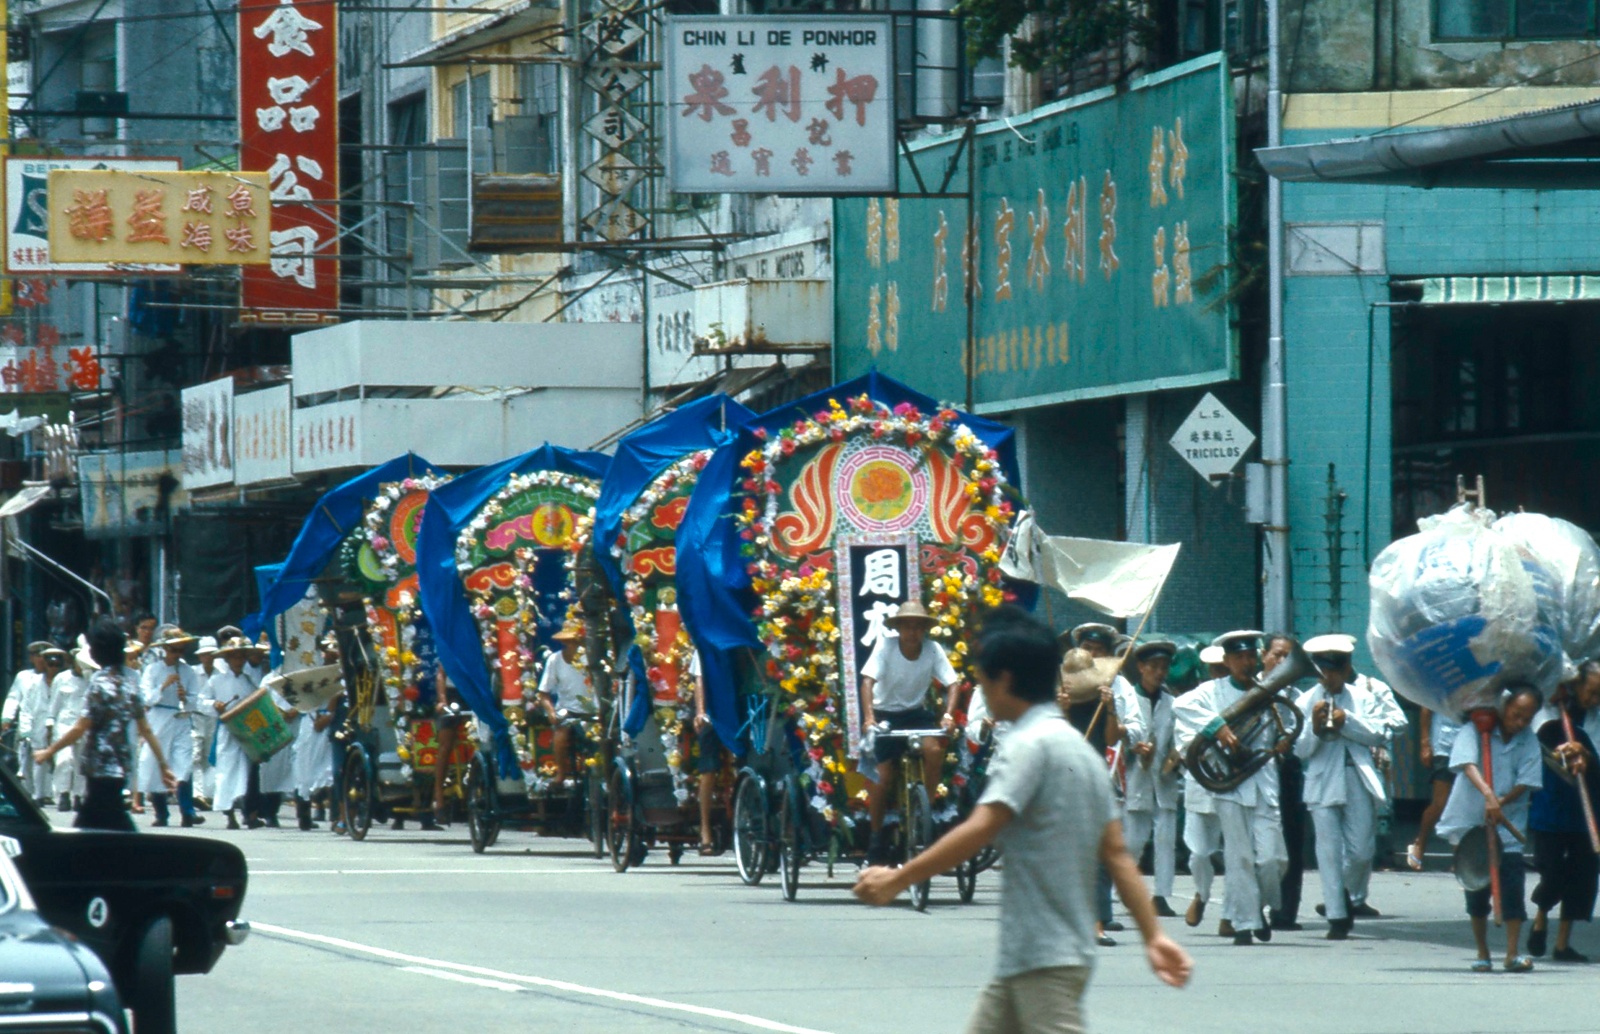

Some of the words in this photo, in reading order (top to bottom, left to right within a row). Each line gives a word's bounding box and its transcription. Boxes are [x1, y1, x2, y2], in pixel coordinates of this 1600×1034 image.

[683, 30, 726, 46] CHIN
[737, 30, 755, 46] LI
[767, 30, 792, 46] DE
[803, 29, 877, 46] PONHOR
[253, 0, 324, 289] 食品公司
[1199, 410, 1225, 419] L.S.
[1186, 447, 1240, 460] TRICICLOS
